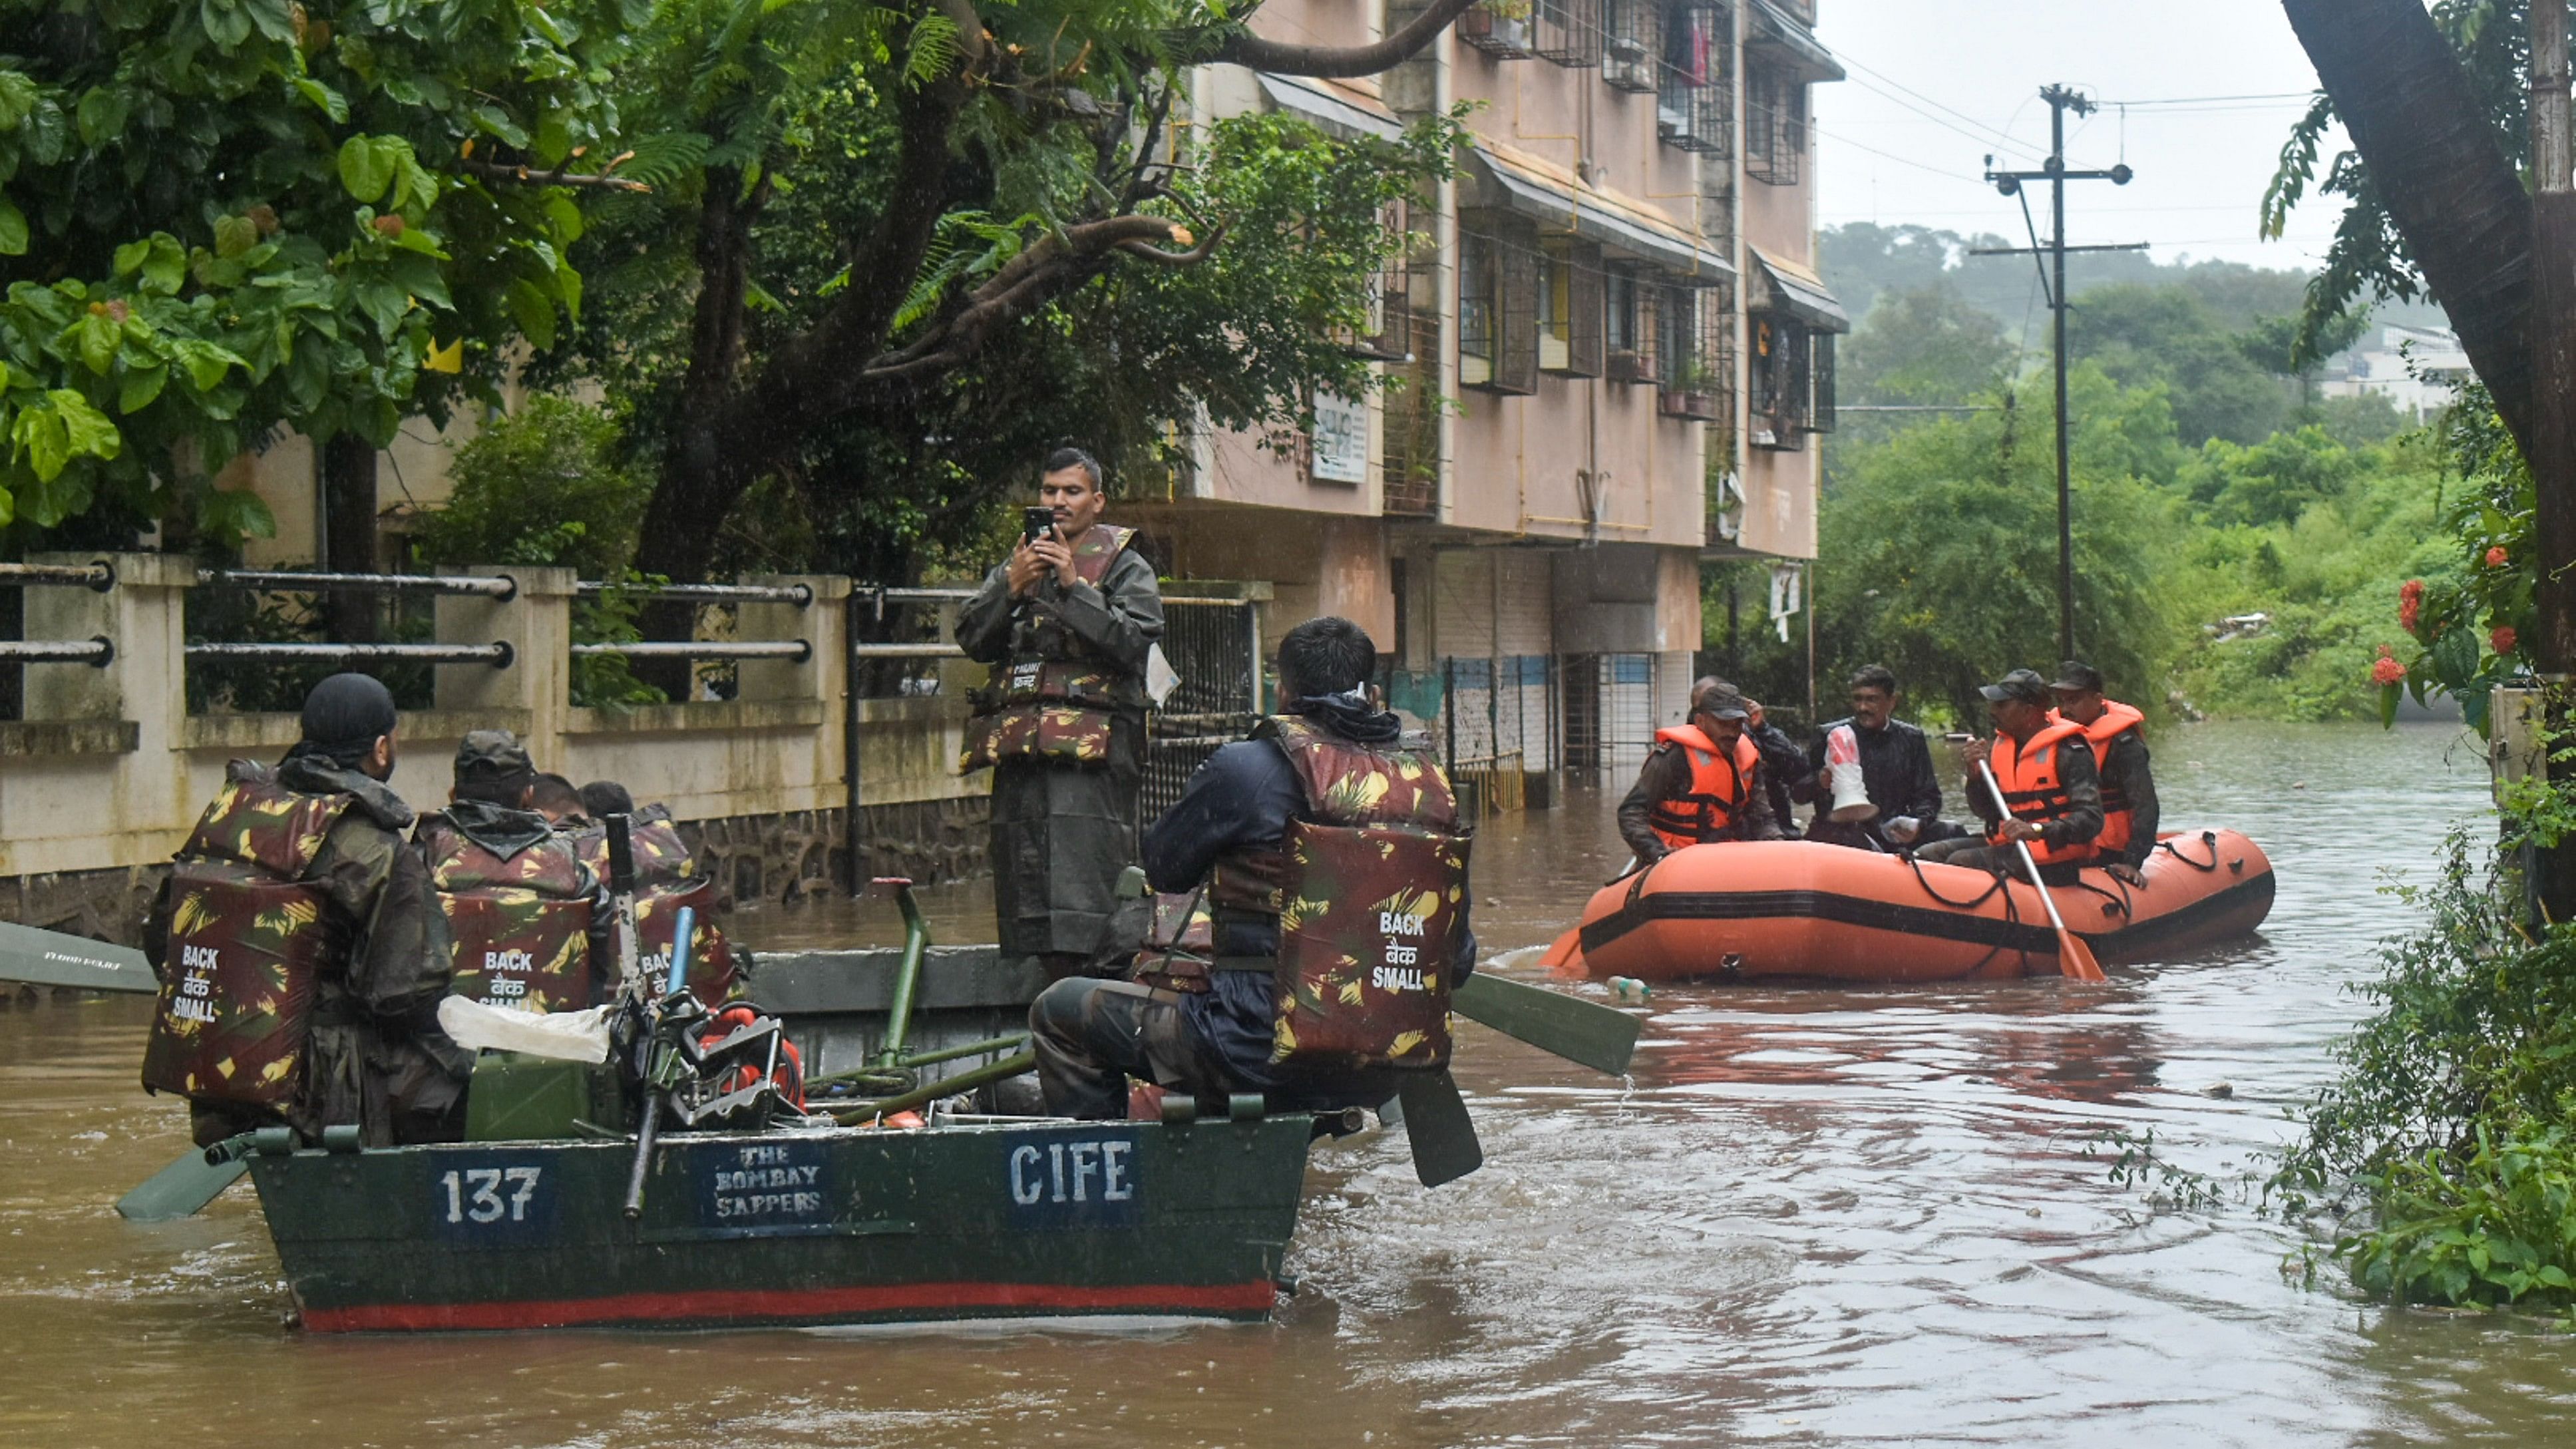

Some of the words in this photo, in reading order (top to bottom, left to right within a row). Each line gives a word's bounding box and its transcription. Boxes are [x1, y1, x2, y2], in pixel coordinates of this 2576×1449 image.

[1380, 911, 1425, 936] BACK
[182, 944, 220, 970] BACK
[485, 951, 533, 972] BACK
[1385, 936, 1417, 965] बैक
[642, 953, 671, 974] BAC
[184, 968, 210, 997] बैक
[490, 972, 526, 996] बैक
[653, 972, 668, 994] बै
[1372, 966, 1423, 990] SMALL
[174, 996, 216, 1023] SMALL
[740, 1145, 789, 1165] THE
[715, 1166, 821, 1191] BOMBAY
[1011, 1141, 1134, 1205] CIFE
[441, 1166, 542, 1223] 137
[715, 1191, 821, 1218] SAPPERS
